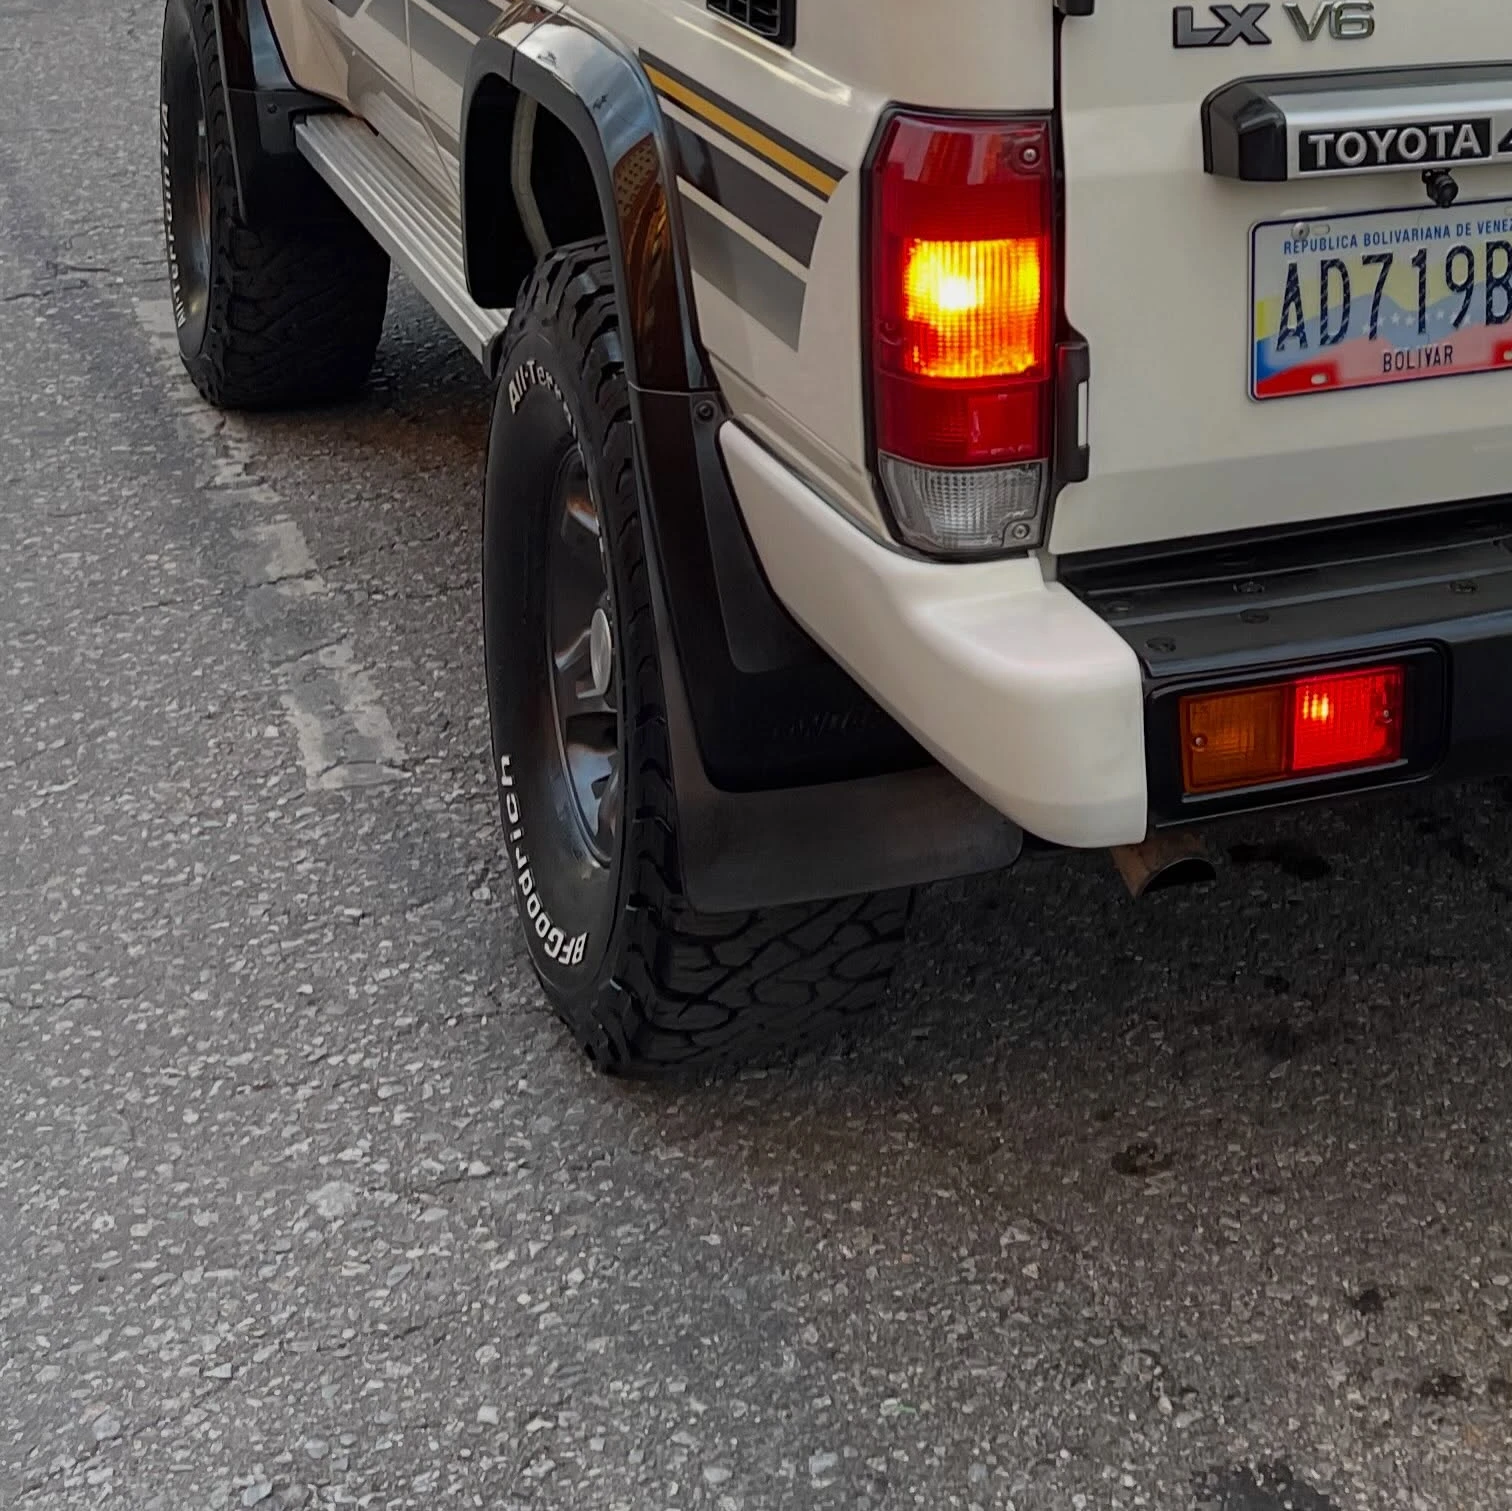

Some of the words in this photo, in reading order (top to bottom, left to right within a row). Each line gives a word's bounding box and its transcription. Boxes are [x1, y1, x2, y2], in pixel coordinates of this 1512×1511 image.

[1172, 2, 1272, 49] LX
[1281, 0, 1375, 41] V6
[1307, 123, 1485, 169] TOYOTA
[1283, 233, 1359, 255] REPUBLICA
[1362, 223, 1452, 247] BOLIVARIANA
[1455, 222, 1472, 237] DE
[1382, 344, 1454, 373] BOLIVAR
